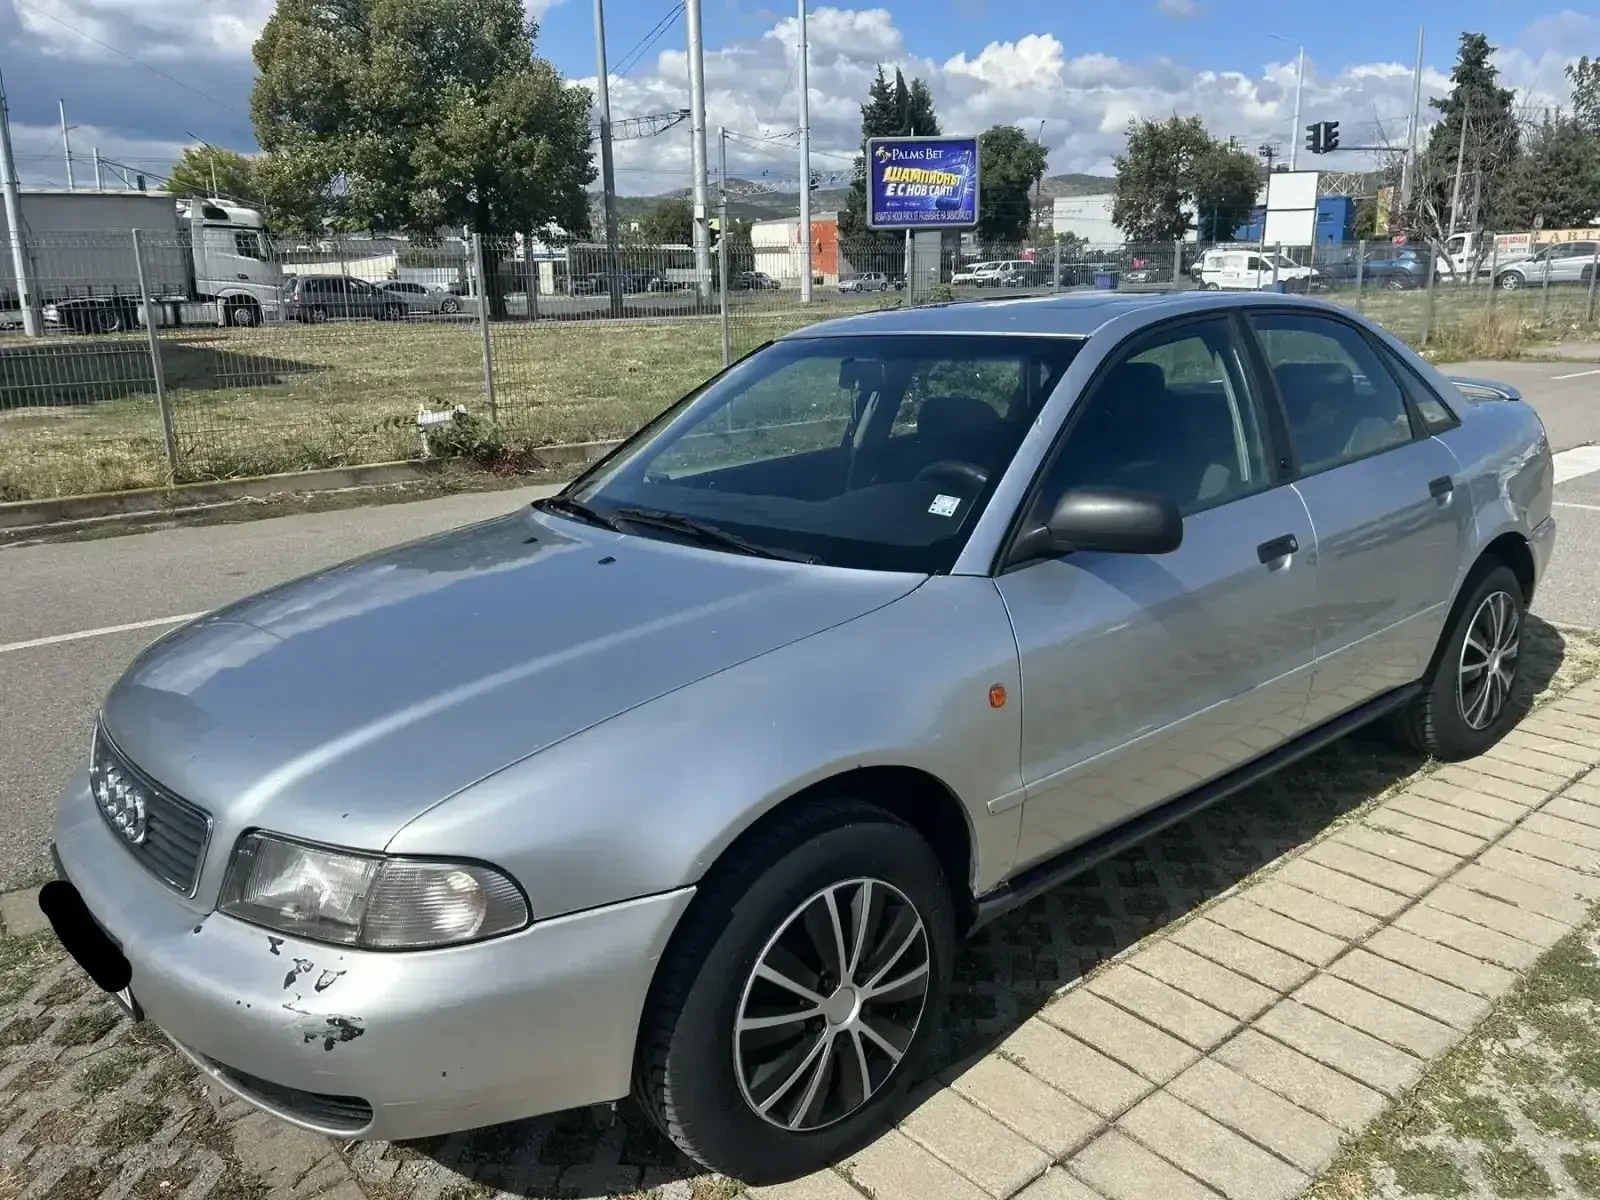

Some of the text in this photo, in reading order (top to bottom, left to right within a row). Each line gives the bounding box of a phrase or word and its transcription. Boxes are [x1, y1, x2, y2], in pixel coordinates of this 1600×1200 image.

[883, 166, 962, 186] ШАМПИОНЪТ
[886, 184, 953, 196] Е С НОВ САЙТ!
[1550, 231, 1600, 243] АВТ
